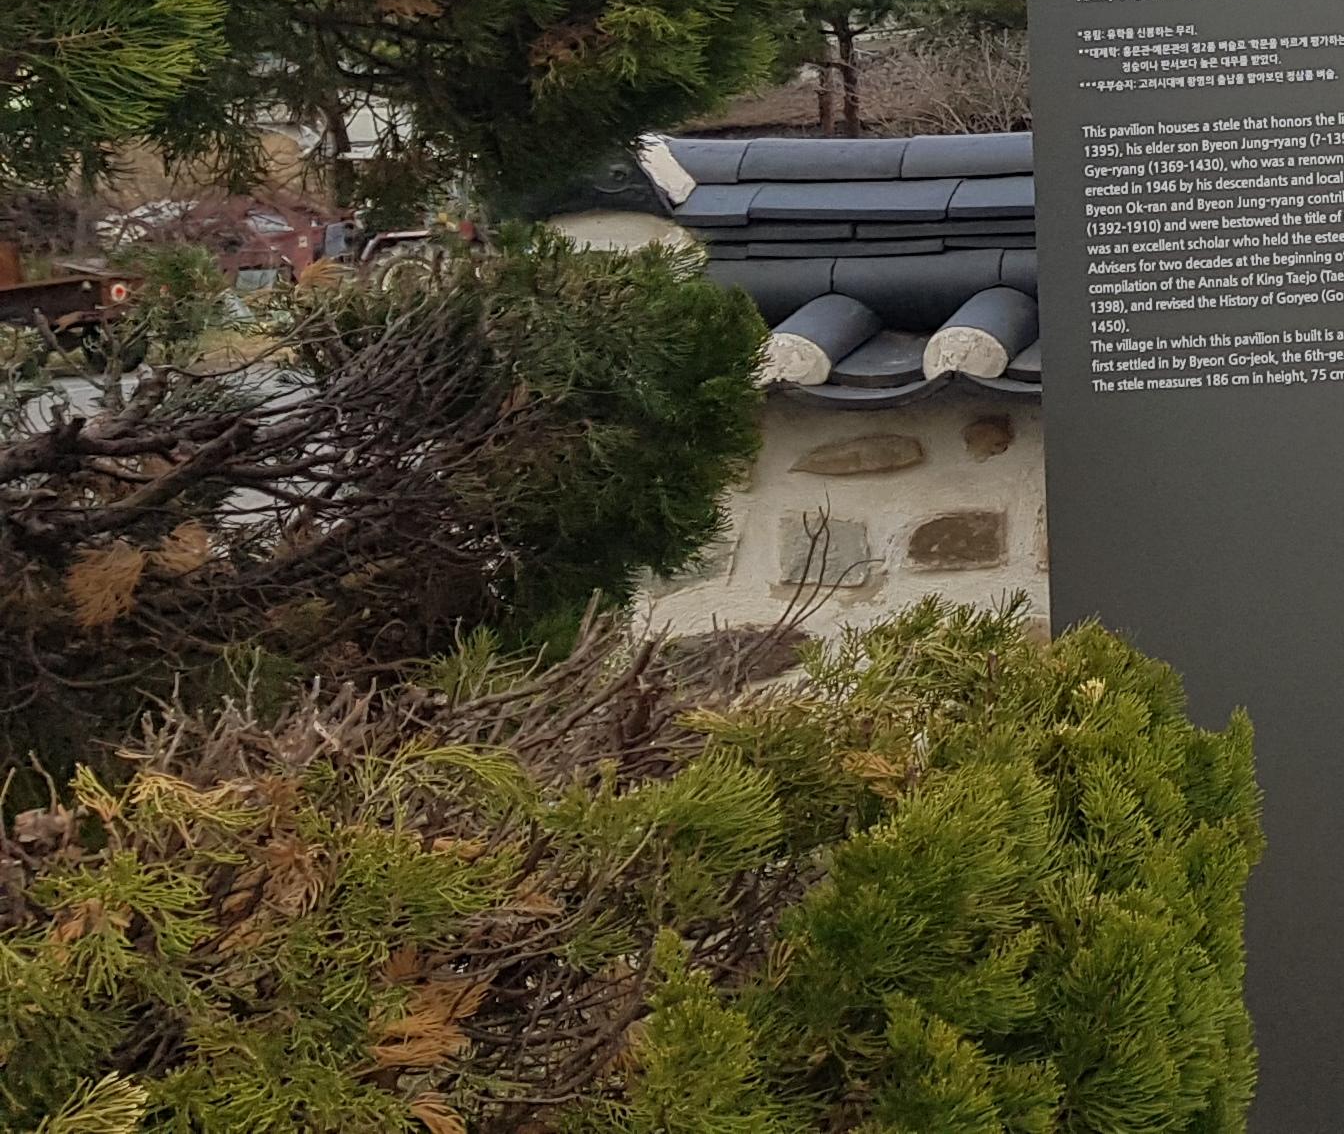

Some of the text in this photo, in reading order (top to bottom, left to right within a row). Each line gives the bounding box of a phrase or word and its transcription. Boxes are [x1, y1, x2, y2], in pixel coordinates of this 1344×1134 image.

[1081, 124, 1106, 138] This
[1109, 122, 1154, 138] pavilion
[1157, 121, 1199, 134] houses
[1202, 122, 1209, 131] a
[1212, 117, 1240, 131] stele
[1242, 116, 1268, 129] that
[1270, 115, 1312, 128] honors
[1314, 112, 1335, 125] the
[1085, 203, 1122, 217] Byeon
[1125, 200, 1167, 213] Ok-ran
[1170, 197, 1193, 211] and
[1197, 197, 1233, 211] Byeon
[1236, 195, 1304, 209] Jung-ryang
[1087, 260, 1136, 274] Advisers
[1138, 258, 1156, 271] for
[1158, 259, 1182, 270] two
[1185, 255, 1233, 269] decades
[1235, 255, 1248, 266] at
[1249, 253, 1270, 266] the
[1272, 250, 1331, 266] beginning
[1091, 318, 1129, 333] 1450).
[1091, 378, 1114, 392] The
[1116, 376, 1144, 390] stele
[1146, 377, 1202, 389] measures
[1205, 373, 1228, 386] 186
[1231, 375, 1249, 384] cm
[1252, 371, 1263, 383] in
[1266, 369, 1308, 384] height,
[1310, 368, 1326, 381] 75
